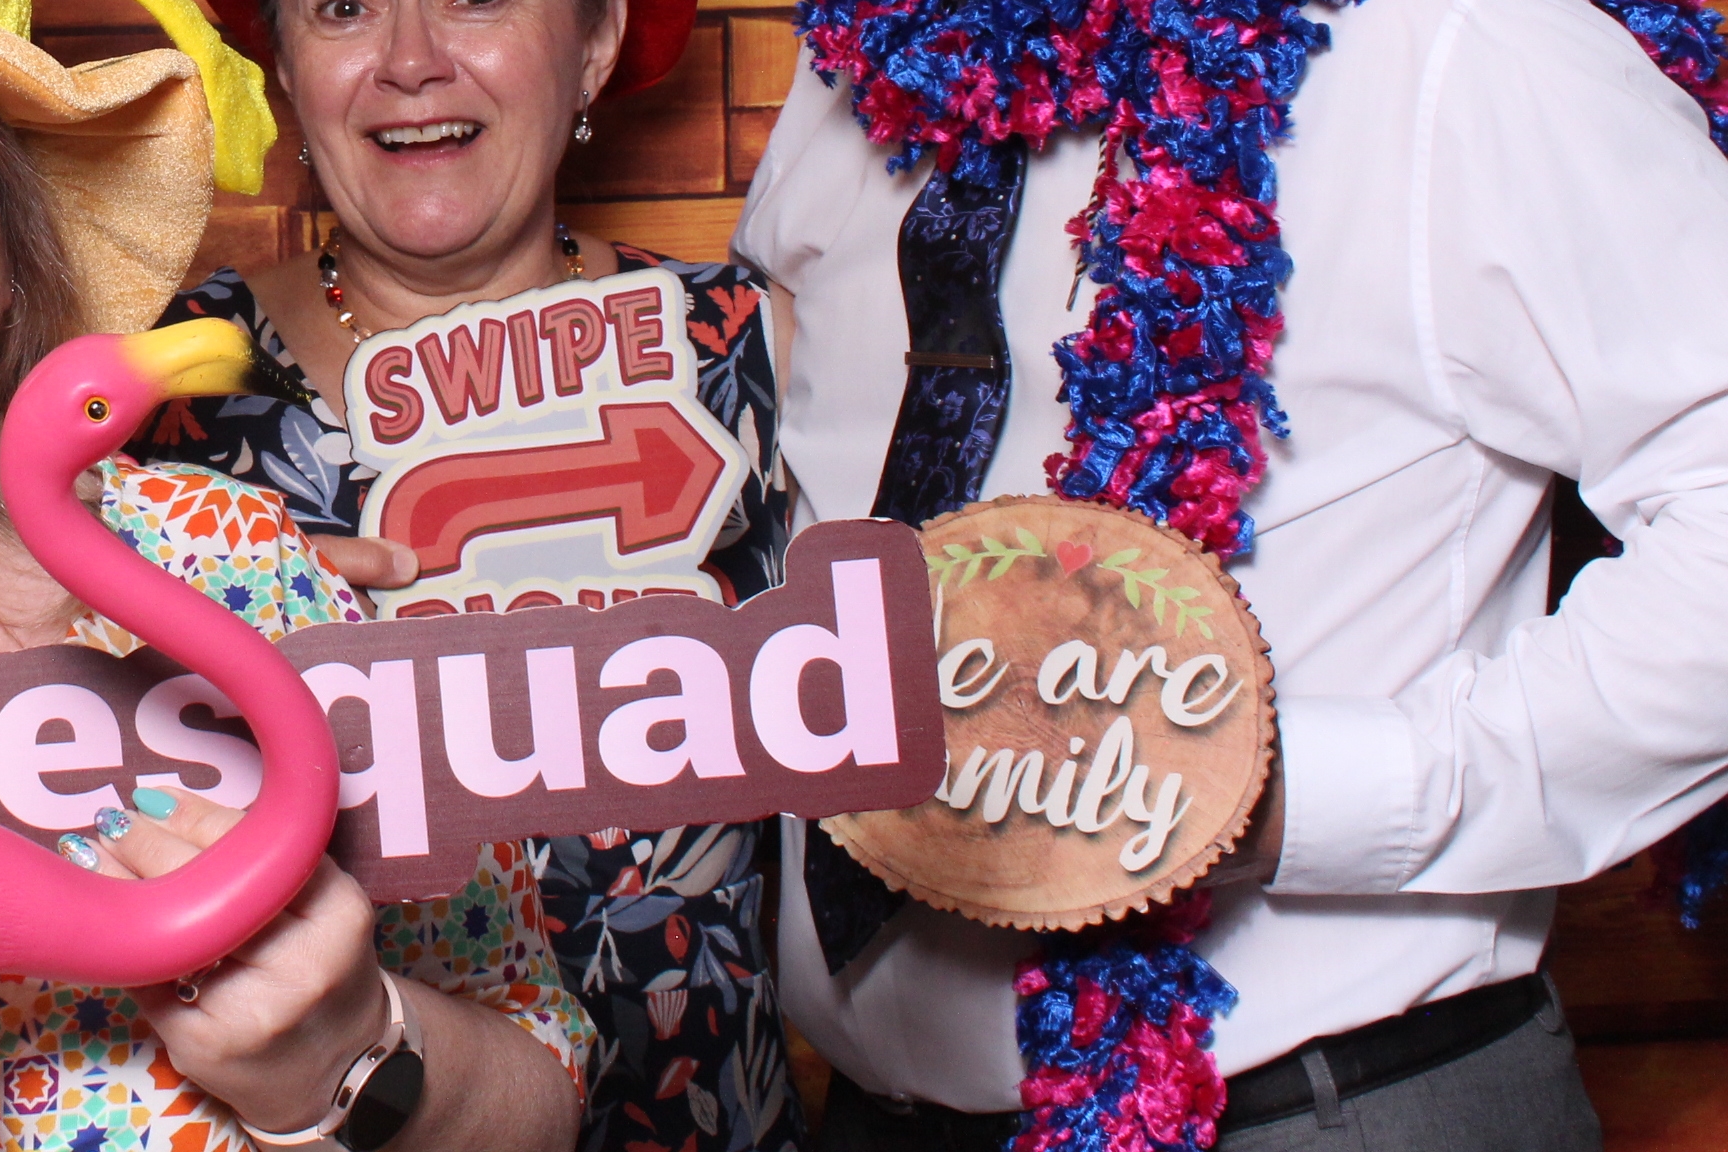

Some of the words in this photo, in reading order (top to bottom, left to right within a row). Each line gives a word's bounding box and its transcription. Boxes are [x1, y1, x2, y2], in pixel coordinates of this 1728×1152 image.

[364, 286, 674, 445] SWIPE
[1037, 638, 1245, 727] are
[935, 715, 1194, 872] mily
